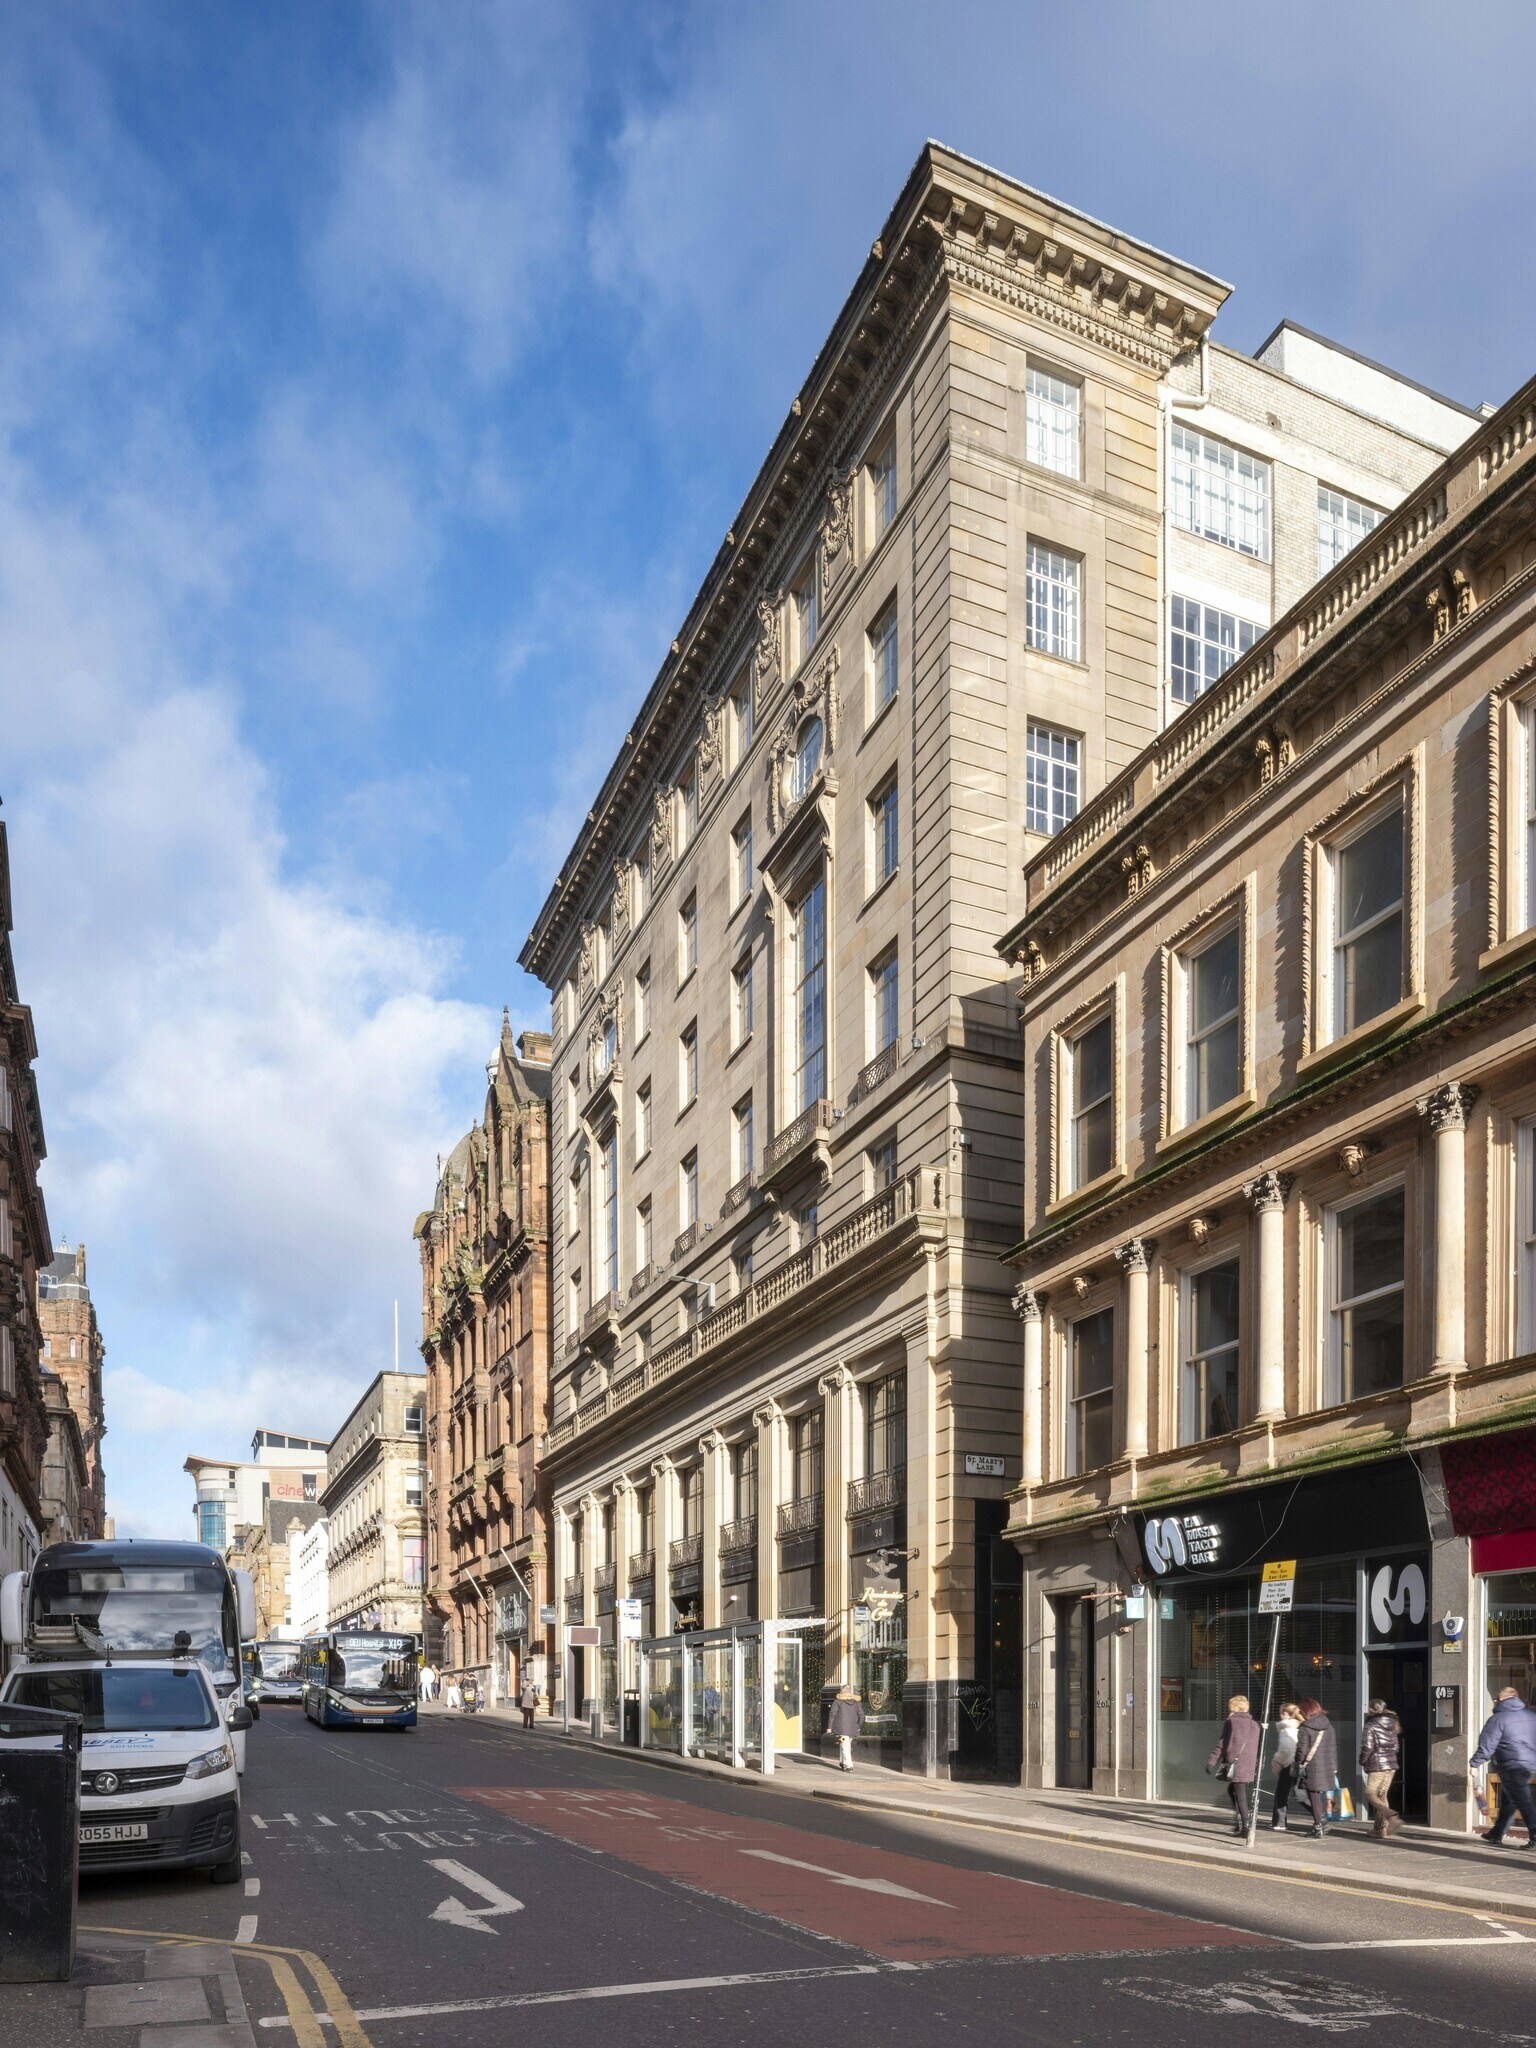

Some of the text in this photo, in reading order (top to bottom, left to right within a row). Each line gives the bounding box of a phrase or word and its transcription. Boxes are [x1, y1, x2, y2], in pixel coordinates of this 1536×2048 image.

[976, 1463, 994, 1471] LANE
[979, 1457, 1003, 1465] MARY'S
[1183, 1516, 1200, 1528] LA
[1186, 1525, 1219, 1541] MASA
[1188, 1538, 1219, 1553] TACO
[1191, 1551, 1216, 1565] BAR
[361, 1639, 384, 1648] Hospital
[388, 1639, 403, 1650] X19
[249, 1807, 480, 1829] SOUTH
[114, 1825, 142, 1839] HJJ
